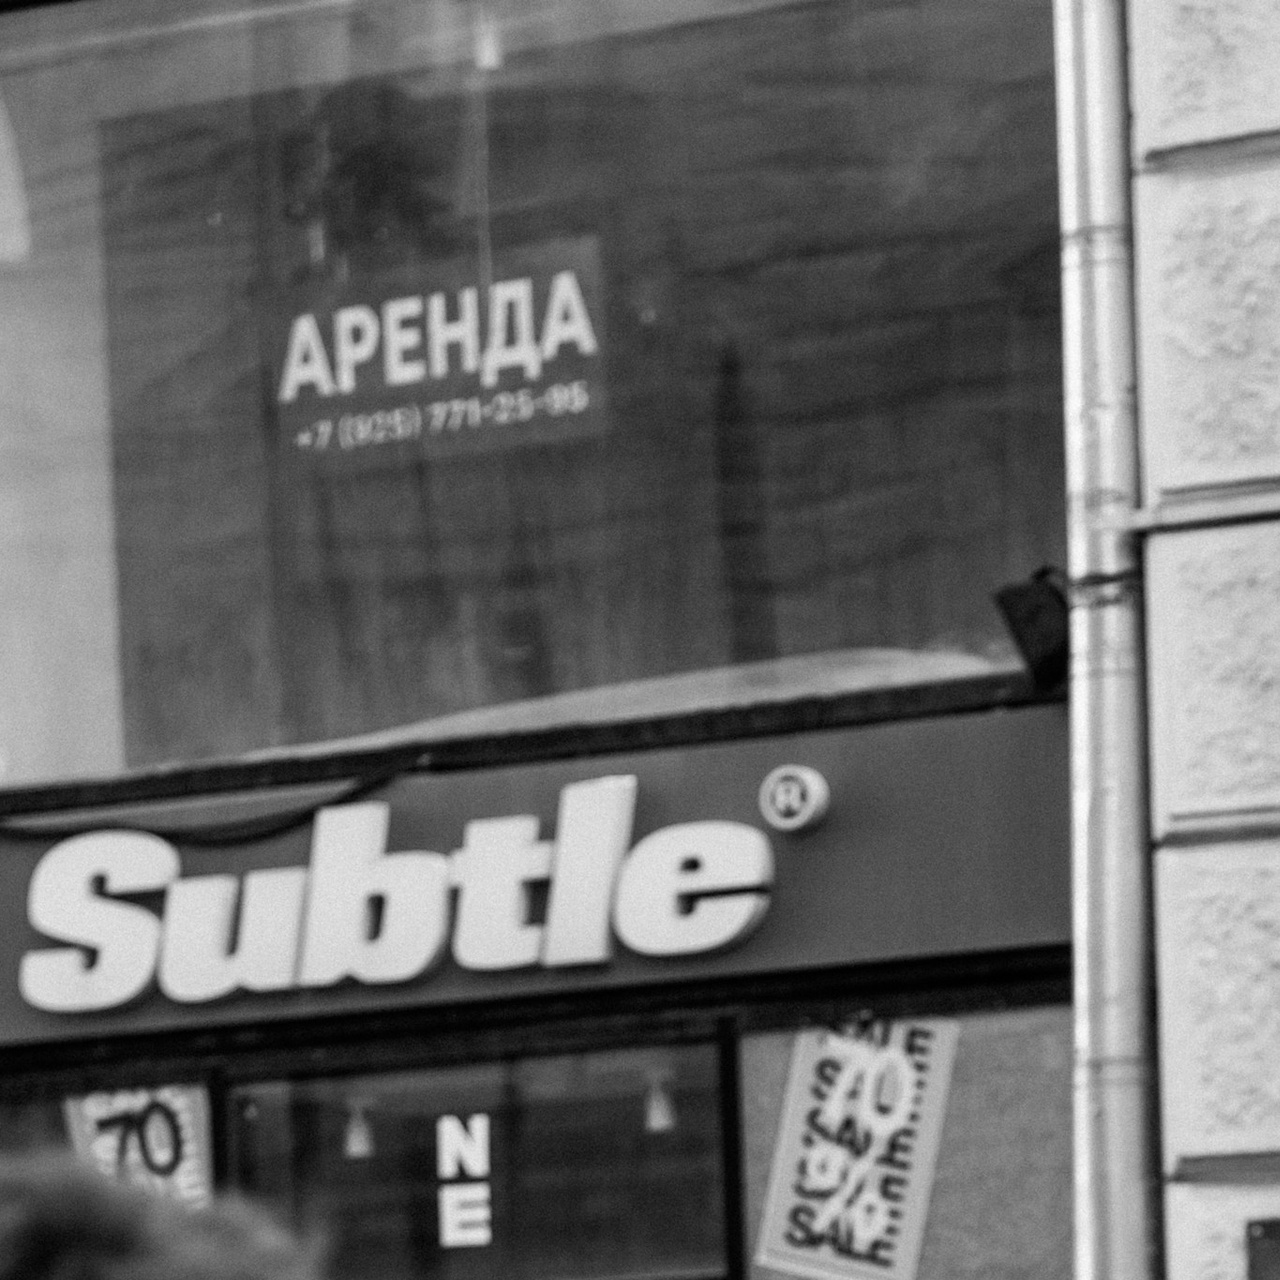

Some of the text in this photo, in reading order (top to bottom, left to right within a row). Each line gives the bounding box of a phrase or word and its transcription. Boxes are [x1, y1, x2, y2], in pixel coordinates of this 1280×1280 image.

[279, 271, 597, 403] АРЕНДА
[296, 419, 333, 449] +7
[97, 1101, 183, 1178] 70
